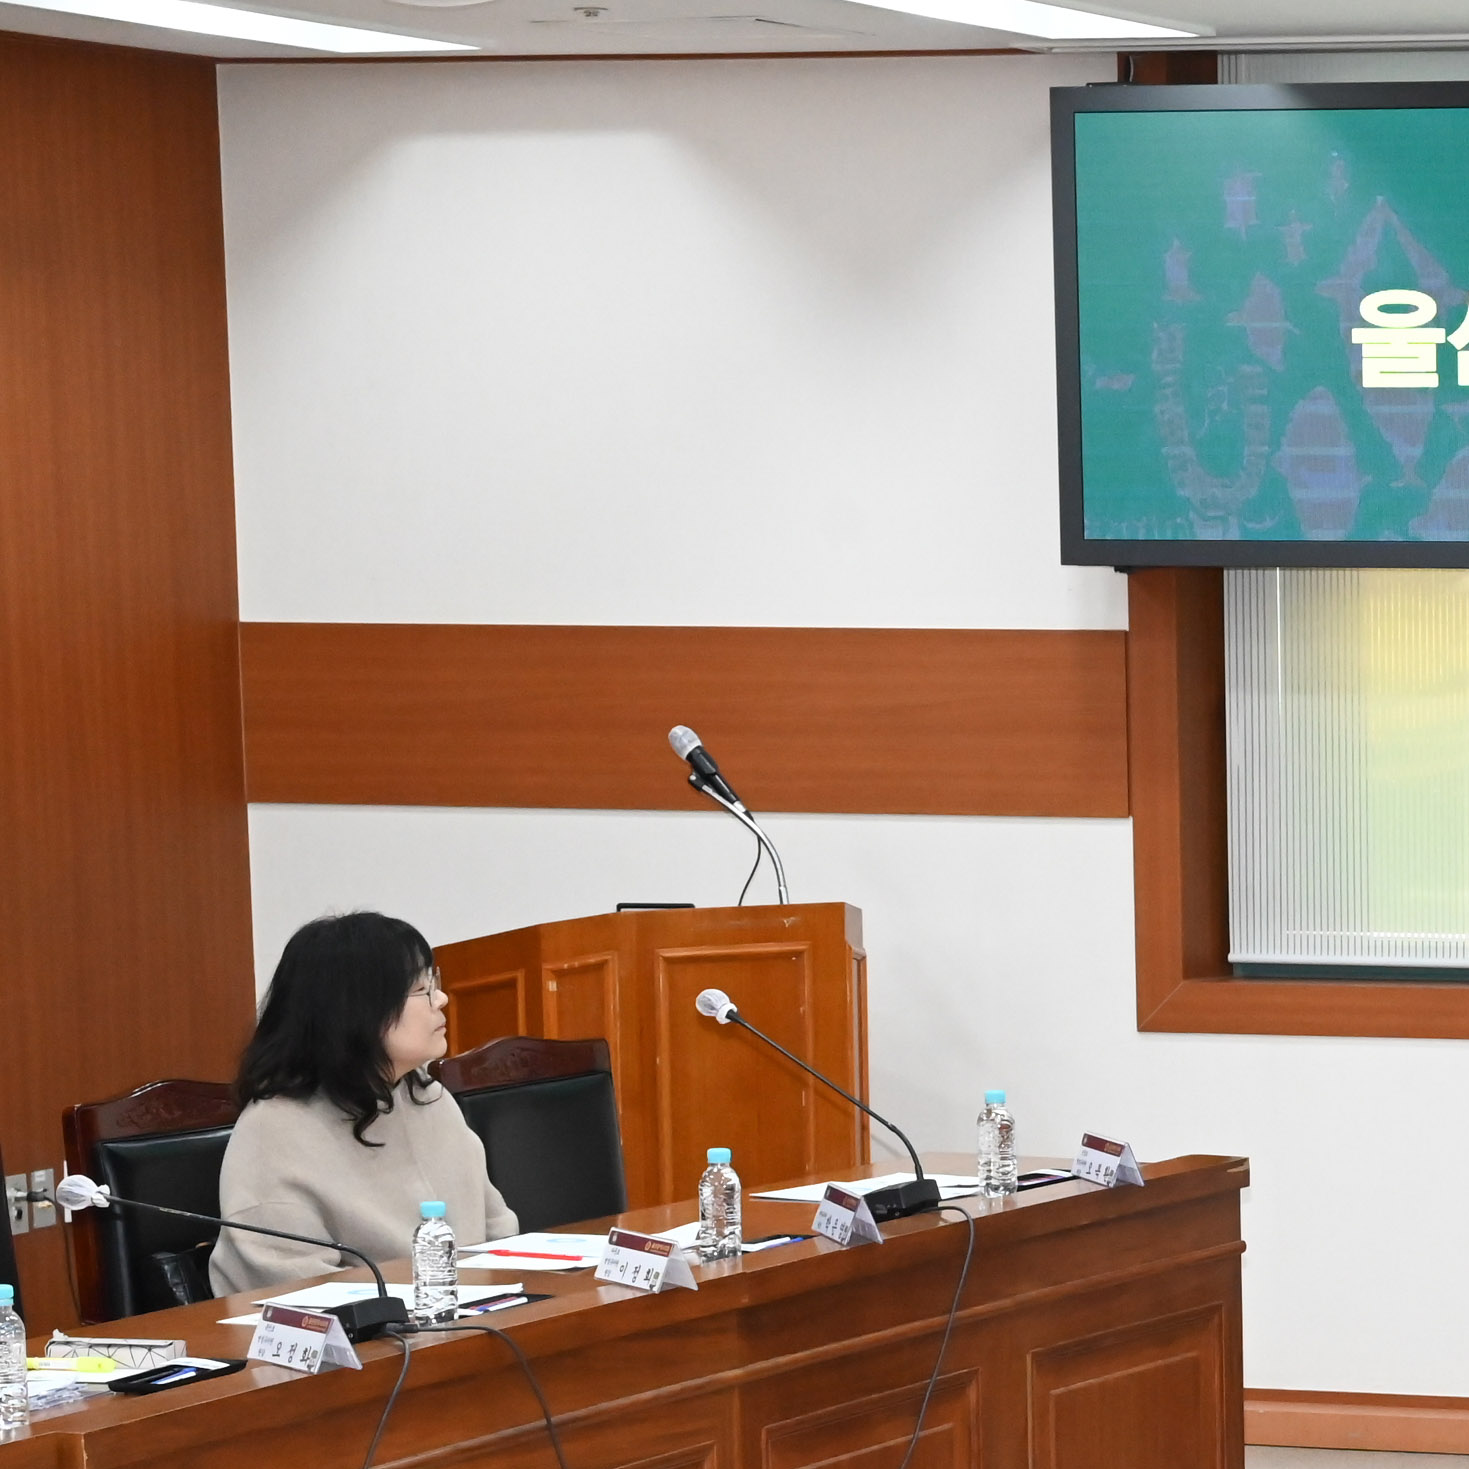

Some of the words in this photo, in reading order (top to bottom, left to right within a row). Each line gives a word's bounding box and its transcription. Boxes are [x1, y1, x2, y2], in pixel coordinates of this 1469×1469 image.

[619, 1261, 629, 1280] 이
[272, 1342, 282, 1357] 오
[288, 1342, 298, 1363] 정
